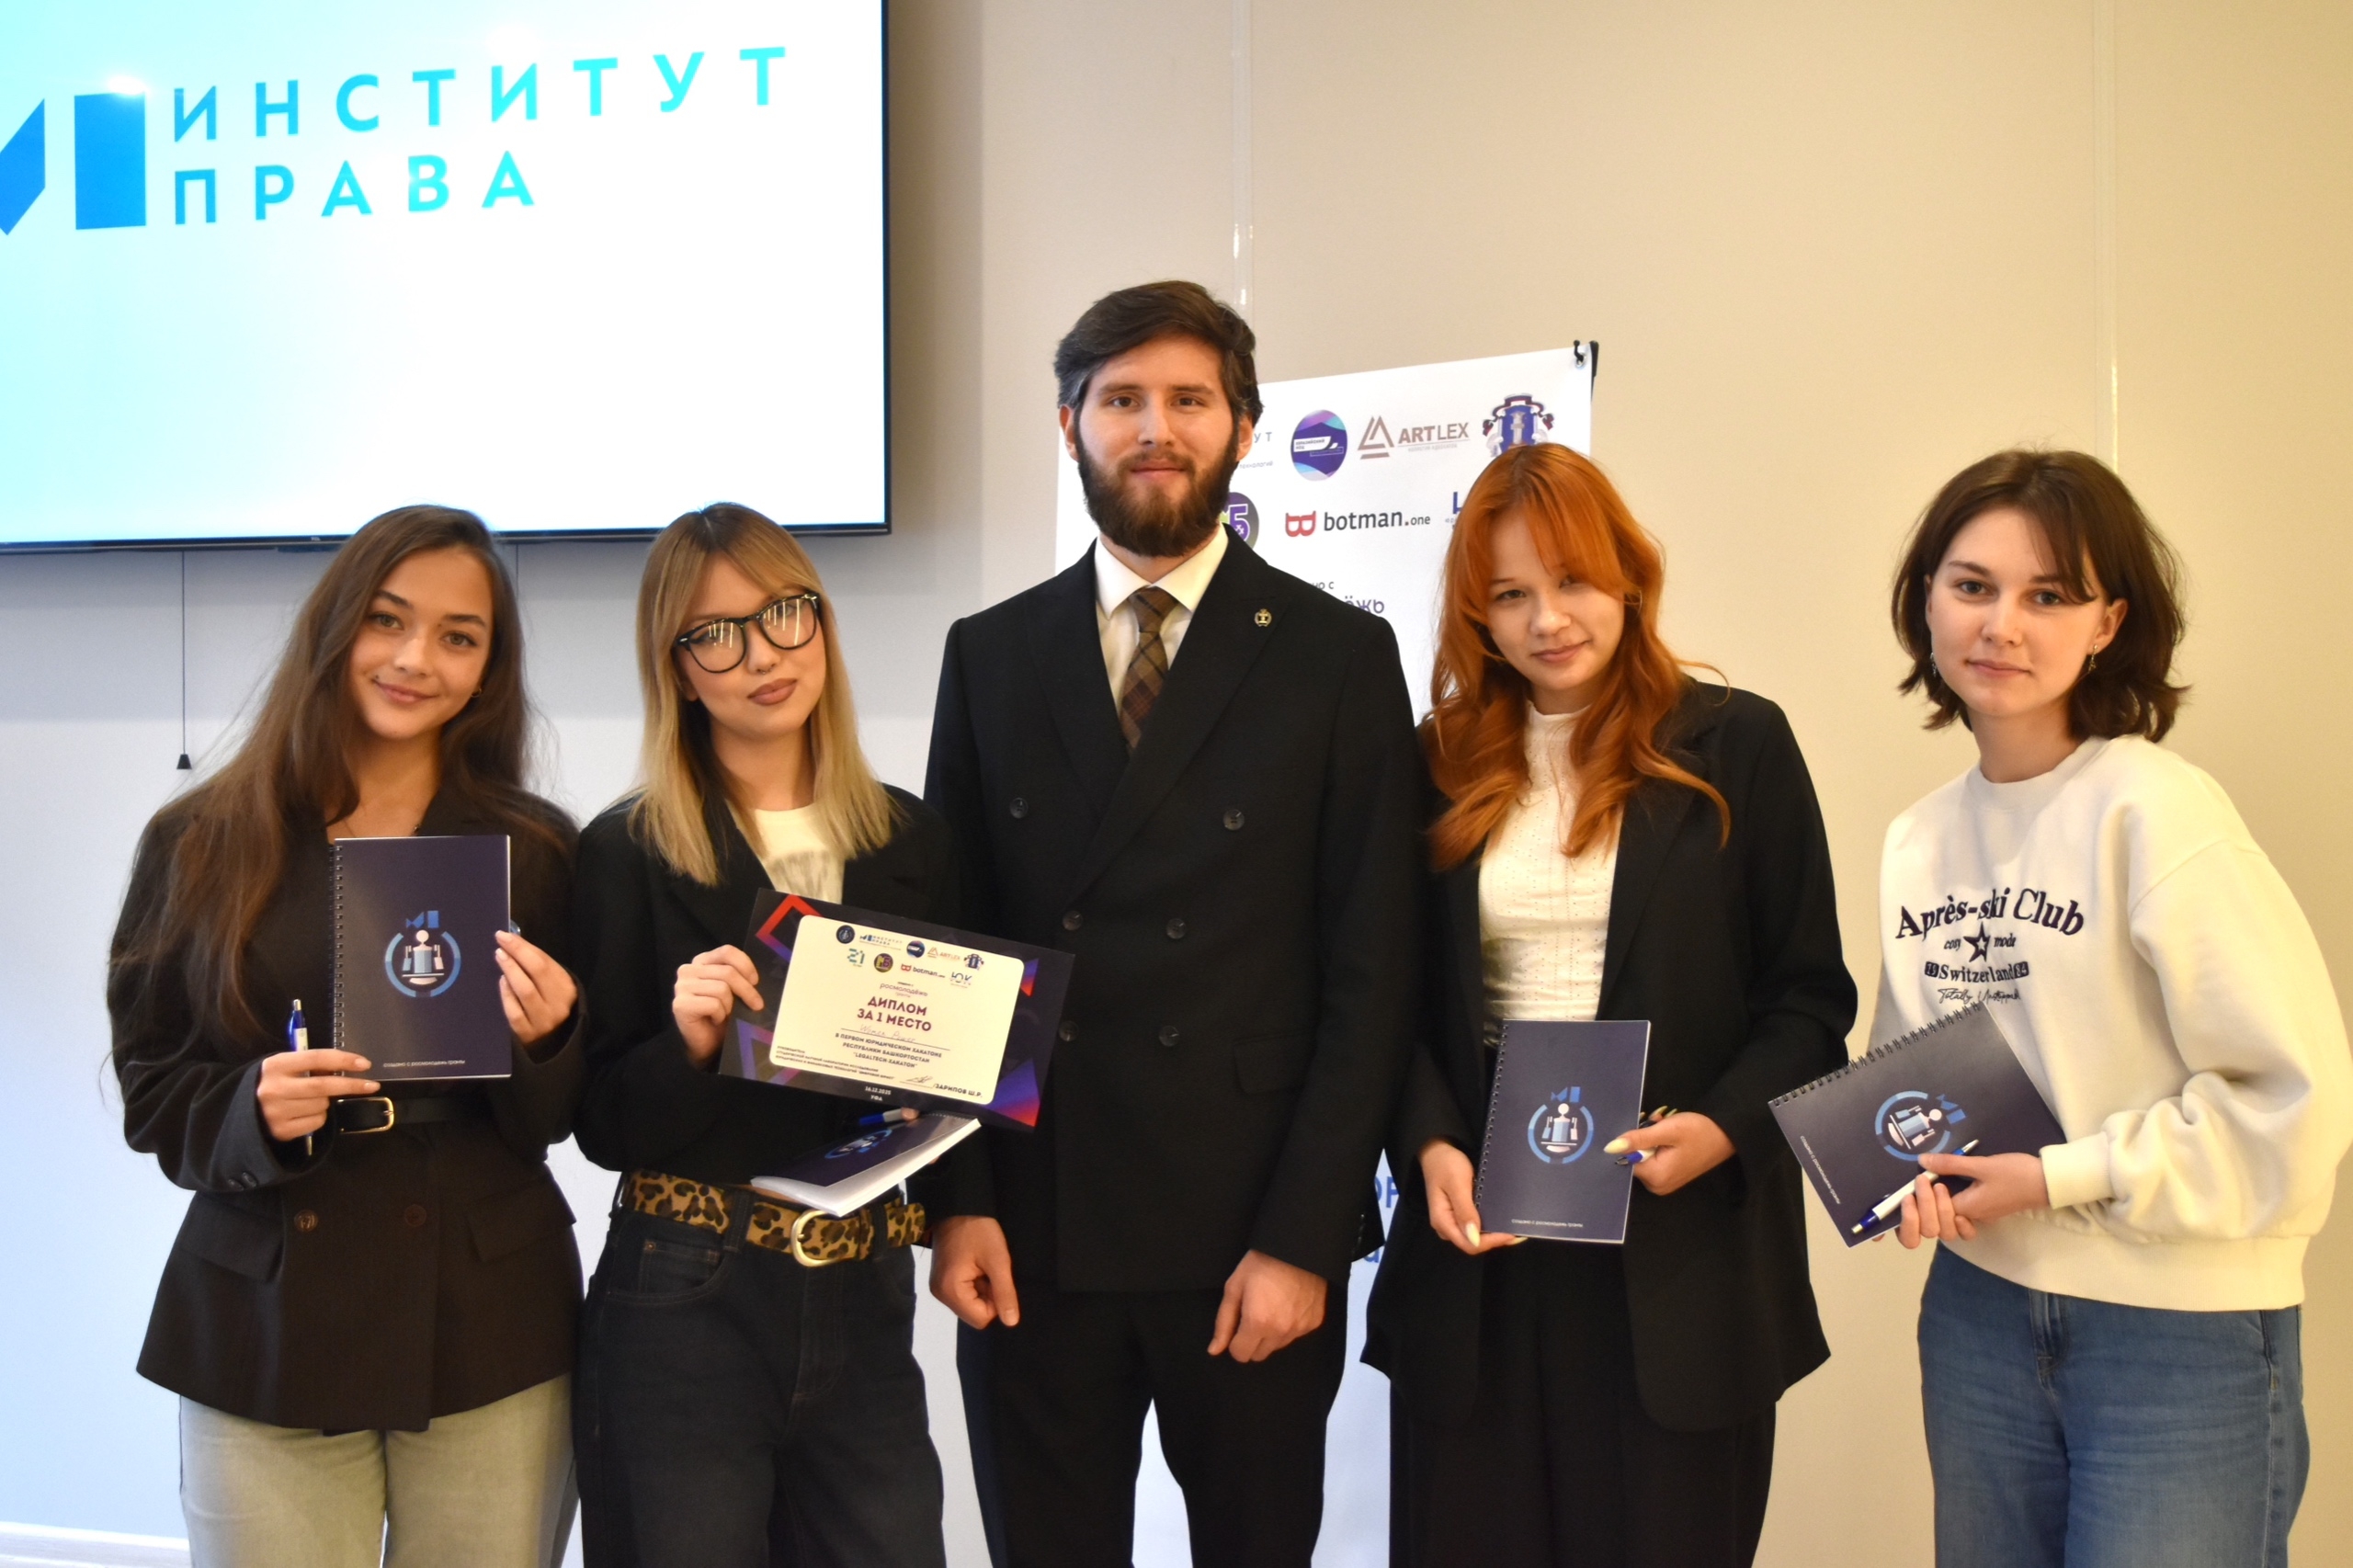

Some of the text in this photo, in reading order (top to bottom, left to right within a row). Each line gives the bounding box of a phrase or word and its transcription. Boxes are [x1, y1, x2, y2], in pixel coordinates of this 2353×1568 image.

[173, 46, 788, 143] ИНСТИТУТ
[174, 150, 536, 226] ПРАВА
[1398, 422, 1469, 445] ARTLEX
[1324, 511, 1431, 532] botman.one
[1895, 887, 2085, 942] Après-ski Club
[1994, 933, 2017, 948] mode
[1938, 963, 2015, 983] Switzerland
[867, 996, 927, 1017] ДИПЛОМ
[857, 1008, 932, 1032] ЗА 1 МЕСТО
[840, 1033, 865, 1043] ПЕРВОМ
[865, 1038, 912, 1051] ЮРИДИЧЕСКОМ
[912, 1048, 942, 1058] ХАКАТОНЕ
[843, 1042, 930, 1063] РЕСПУБЛИКИ БАШКОРТОСТАН
